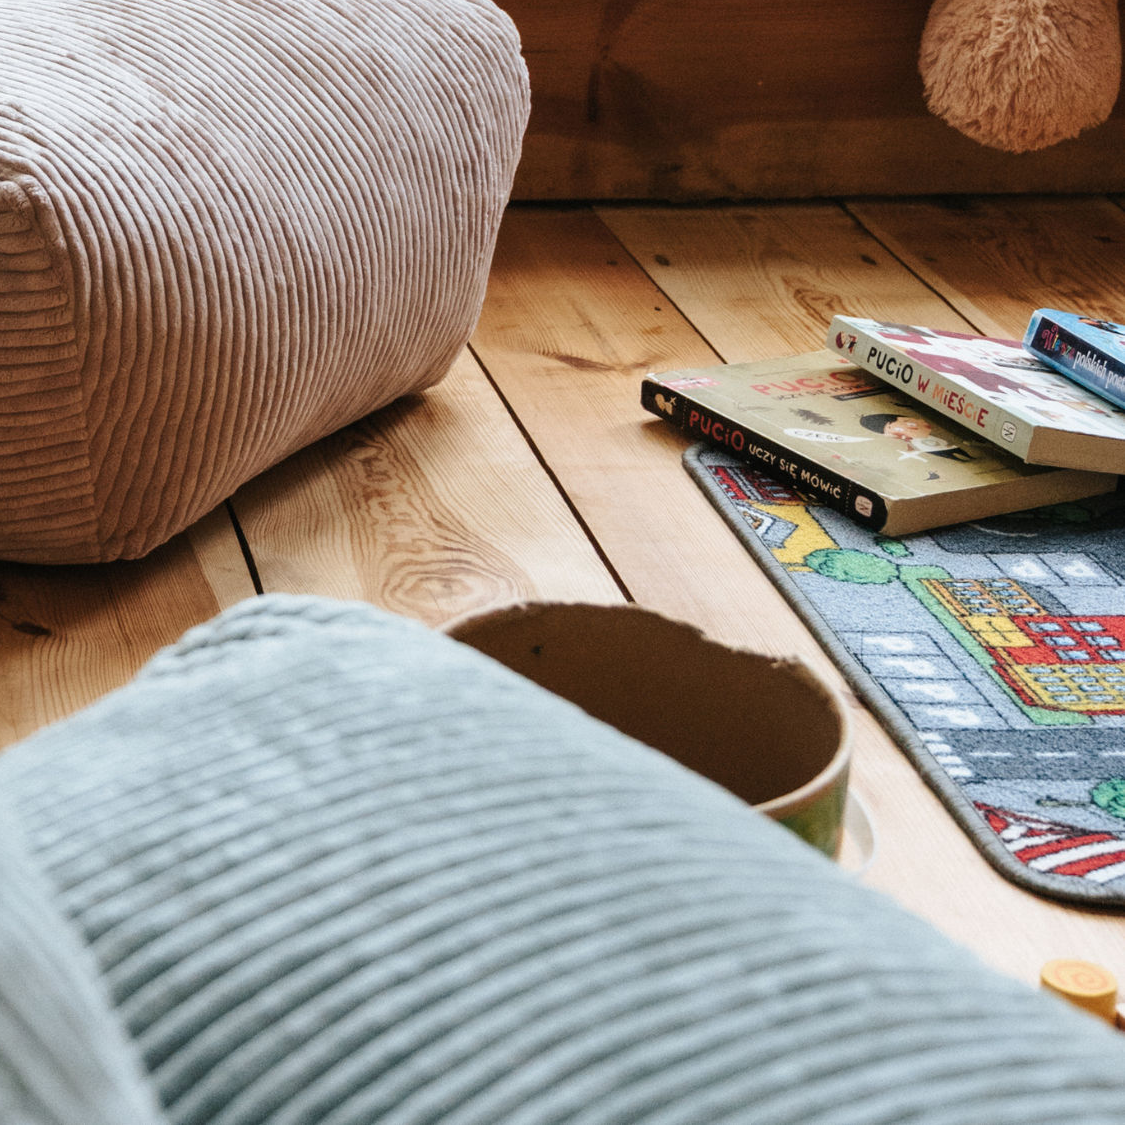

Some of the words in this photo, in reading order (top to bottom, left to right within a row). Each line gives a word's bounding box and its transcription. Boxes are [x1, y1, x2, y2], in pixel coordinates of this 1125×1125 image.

[1072, 350, 1108, 380] polskich
[917, 374, 931, 394] W
[748, 443, 777, 466] UCZY
